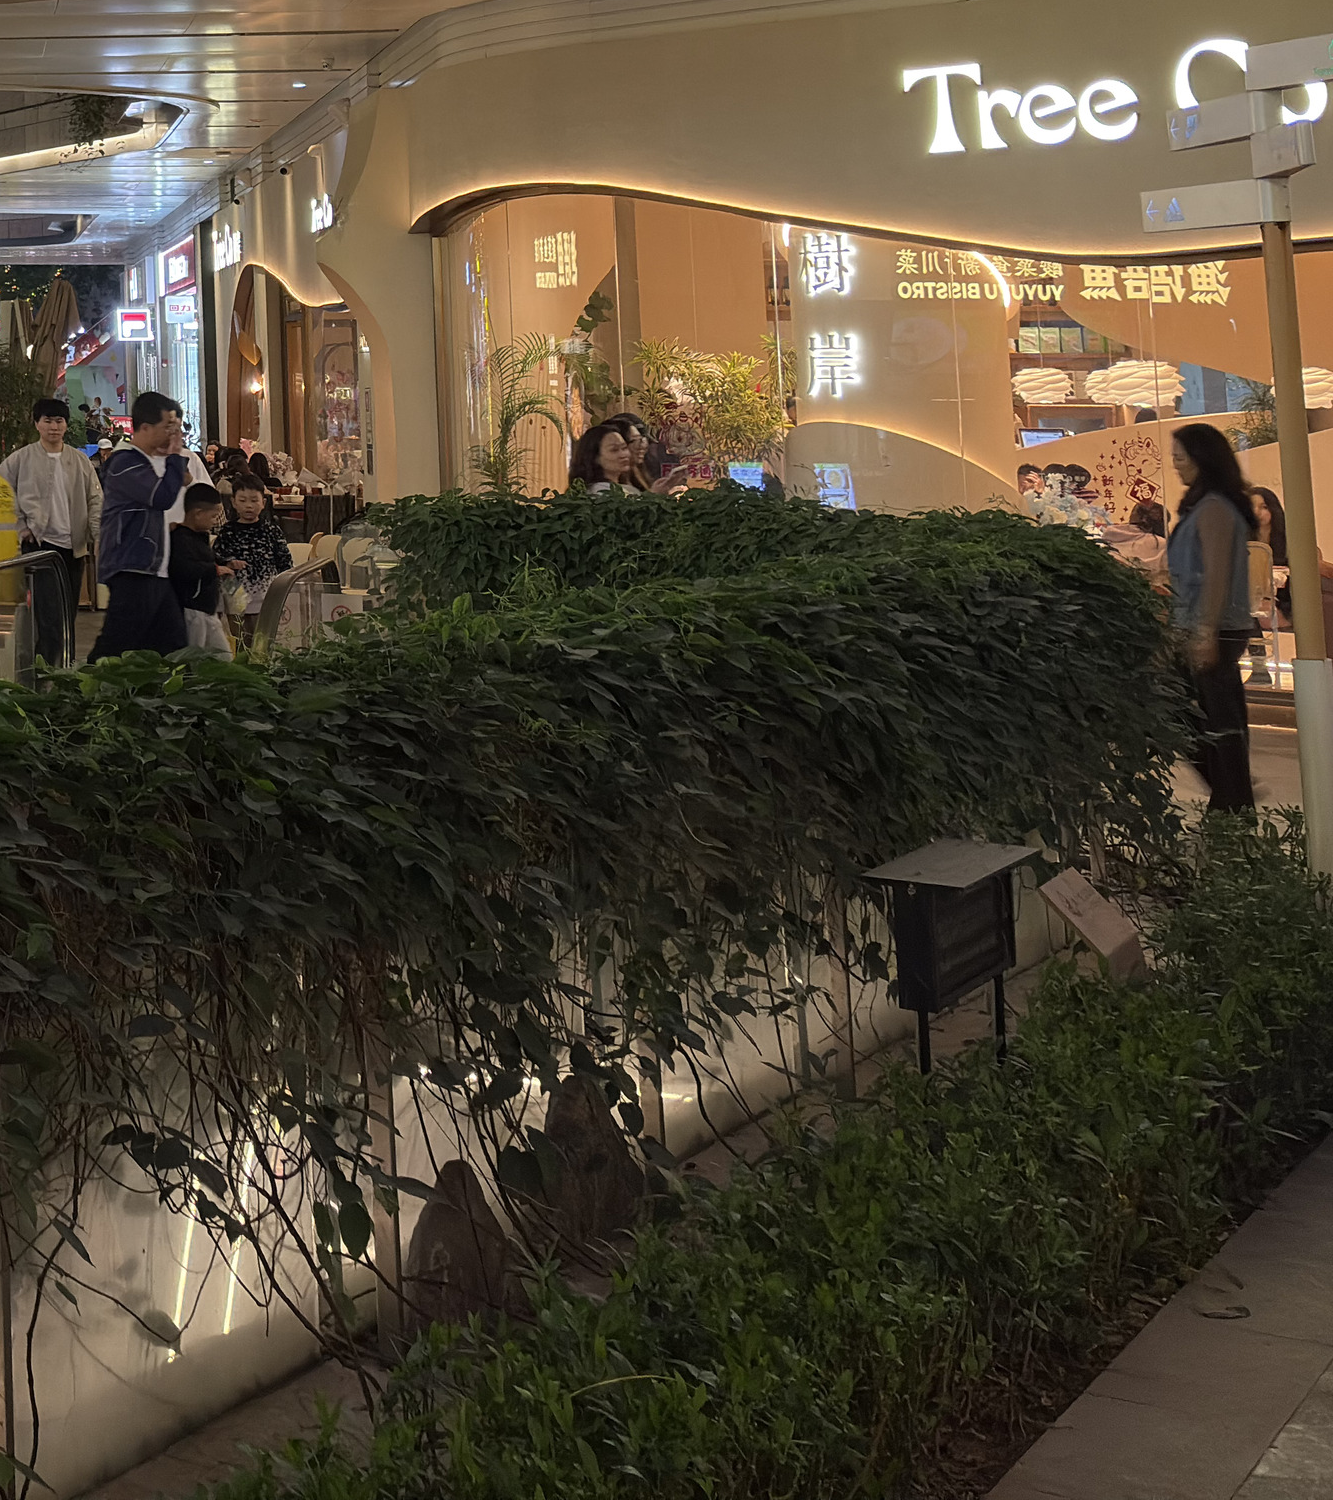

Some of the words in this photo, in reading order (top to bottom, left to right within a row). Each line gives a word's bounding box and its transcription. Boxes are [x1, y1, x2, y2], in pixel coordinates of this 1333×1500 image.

[903, 62, 1139, 154] Tree
[1101, 474, 1116, 514] 新年好
[1134, 482, 1152, 501] 福
